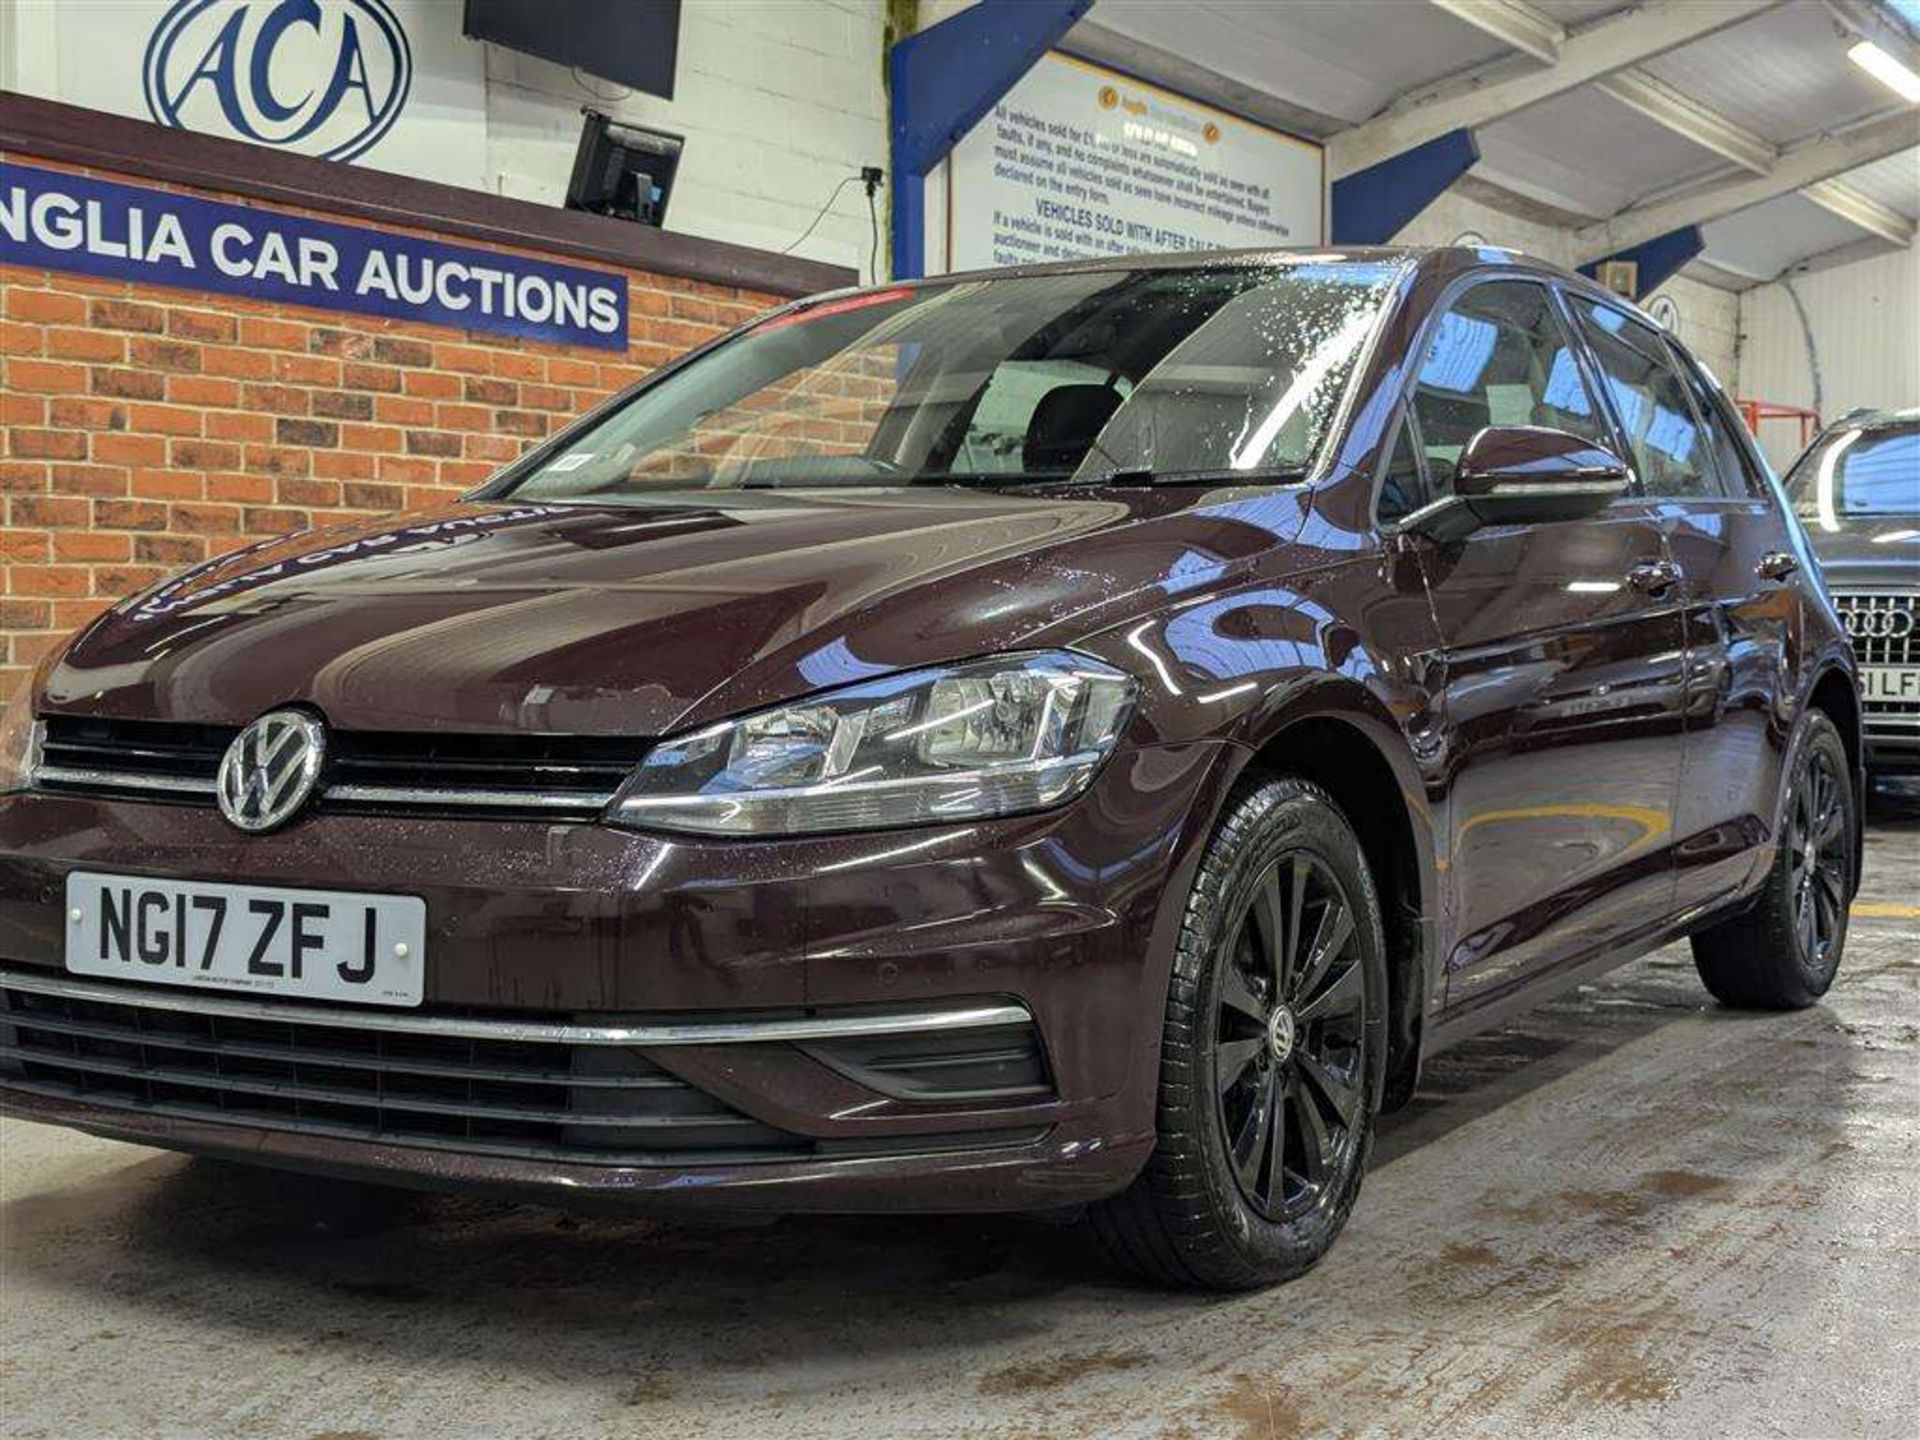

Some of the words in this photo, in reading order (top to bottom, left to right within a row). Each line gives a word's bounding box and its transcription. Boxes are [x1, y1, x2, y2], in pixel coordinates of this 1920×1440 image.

[172, 0, 378, 143] ACA
[1048, 121, 1066, 138] sold
[994, 144, 1017, 162] must
[1056, 142, 1071, 158] and
[994, 162, 1033, 185] declared
[1049, 176, 1062, 192] the
[1066, 182, 1086, 202] entry
[1010, 213, 1042, 234] vehicle
[1055, 225, 1072, 242] sold
[1036, 198, 1092, 228] VEHICLES
[1095, 212, 1122, 235] SOLD
[1126, 220, 1152, 241] WITH
[1155, 228, 1185, 251] AFTER
[210, 223, 339, 290] CAR
[356, 250, 619, 332] AUCTIONS
[1882, 672, 1920, 696] LF
[101, 887, 227, 970] NG17
[248, 899, 376, 984] ZFJ
